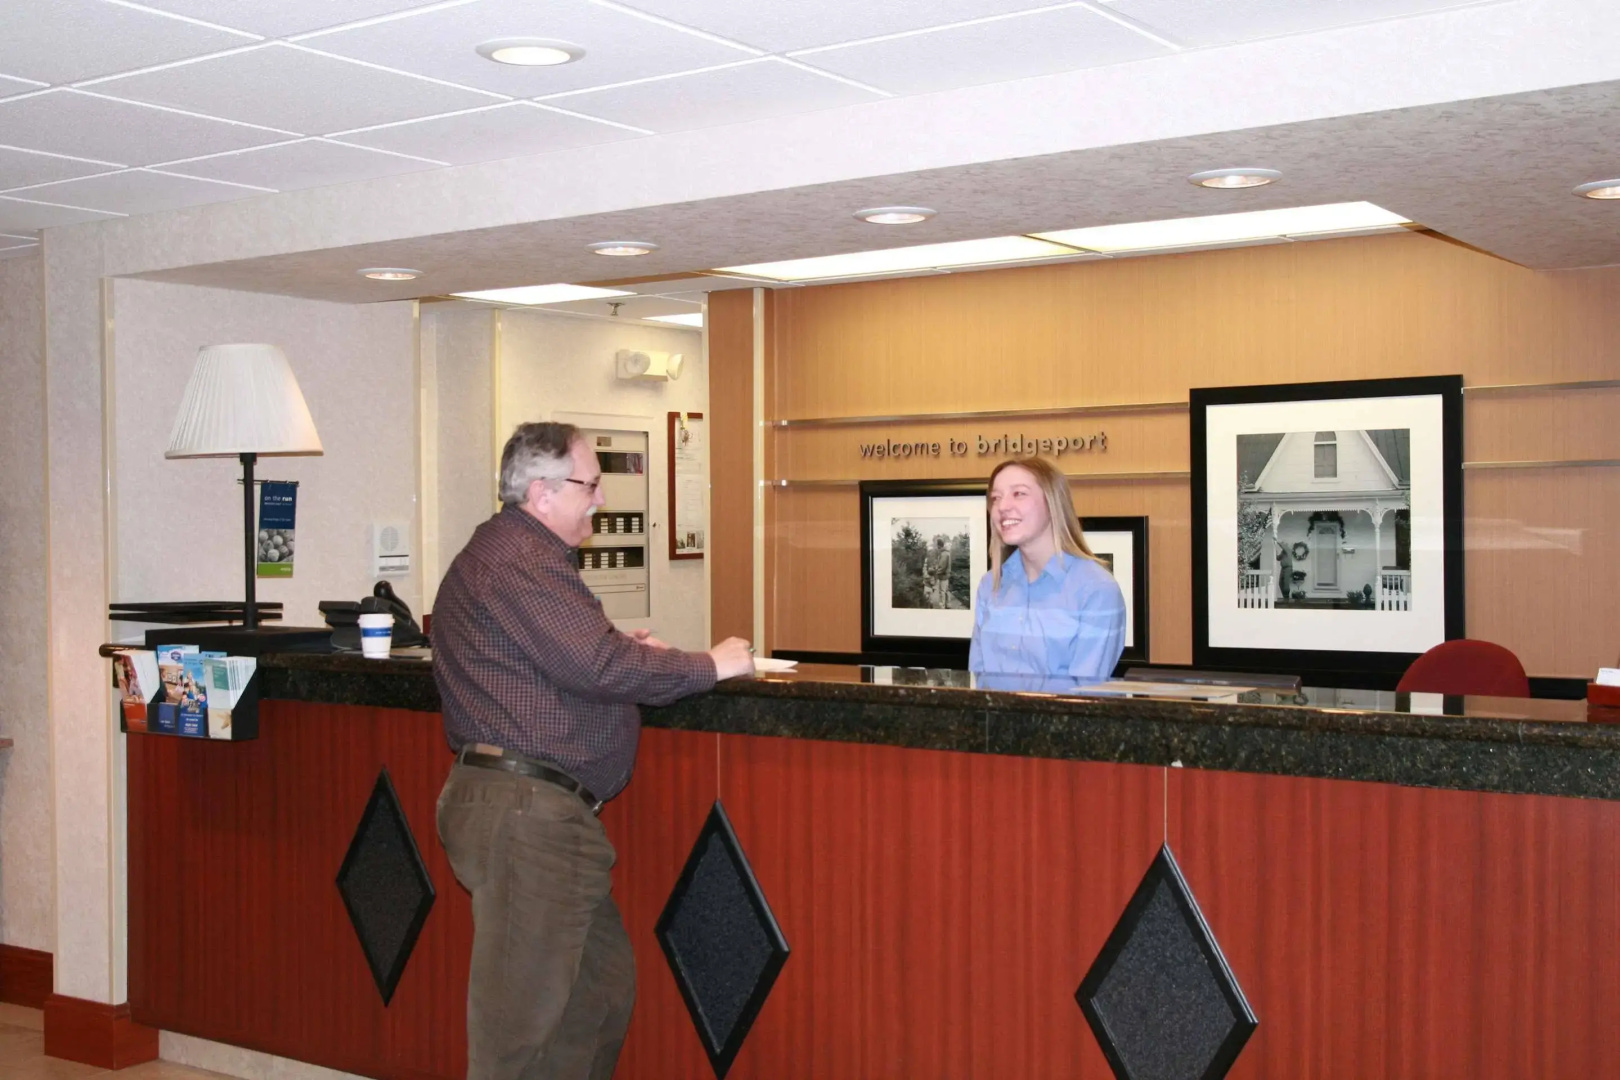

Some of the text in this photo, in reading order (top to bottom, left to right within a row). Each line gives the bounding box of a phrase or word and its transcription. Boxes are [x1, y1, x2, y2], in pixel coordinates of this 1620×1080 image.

[860, 432, 1108, 457] welcome to bridgeport
